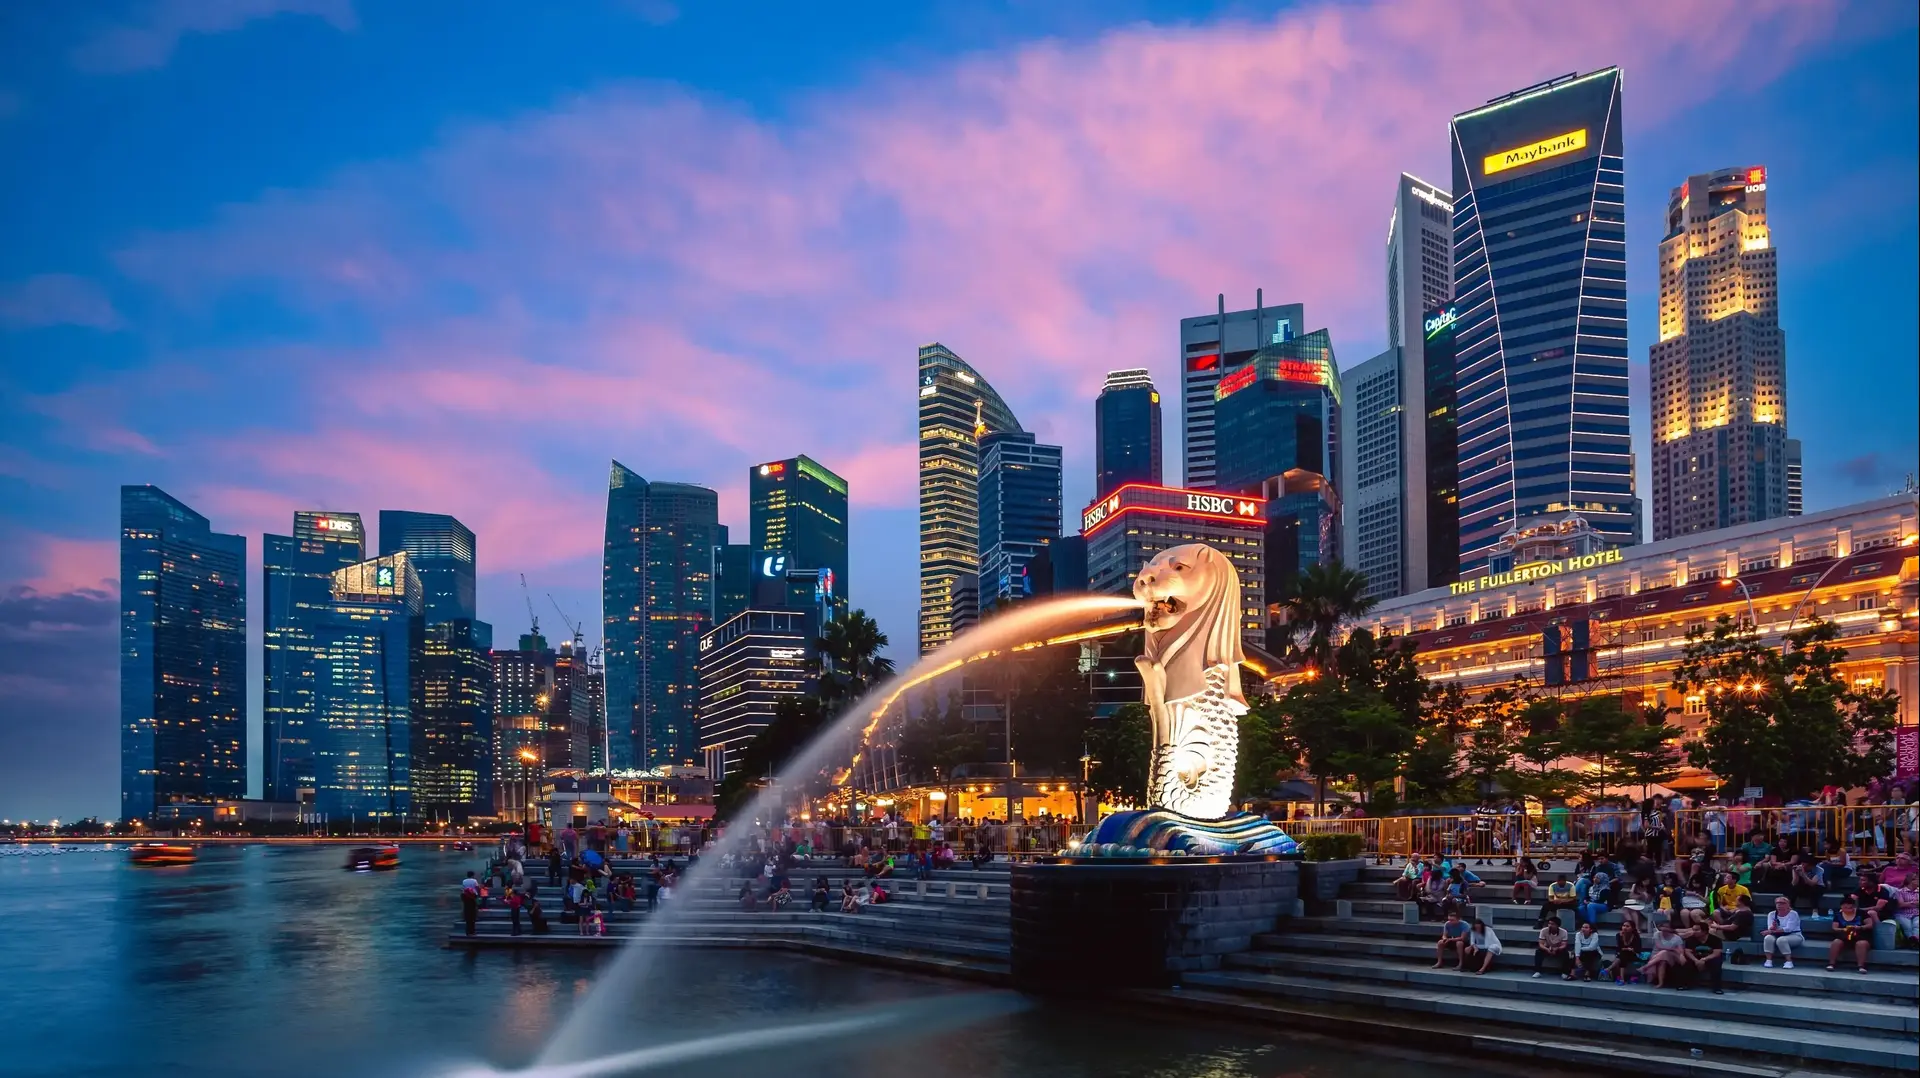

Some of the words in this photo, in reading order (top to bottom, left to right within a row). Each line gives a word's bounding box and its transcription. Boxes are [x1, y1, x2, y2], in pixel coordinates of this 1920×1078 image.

[1506, 137, 1575, 164] Maybank
[1745, 184, 1766, 193] UOB
[1084, 502, 1107, 531] HSBC
[1187, 494, 1233, 514] HSBC
[329, 519, 352, 531] DBS
[1450, 580, 1475, 595] THE
[1480, 561, 1563, 589] FULLERTON
[1569, 549, 1623, 571] HOTEL
[700, 635, 713, 651] OUE
[1900, 734, 1908, 768] MAJULAH
[1906, 732, 1915, 771] SINGAPURA
